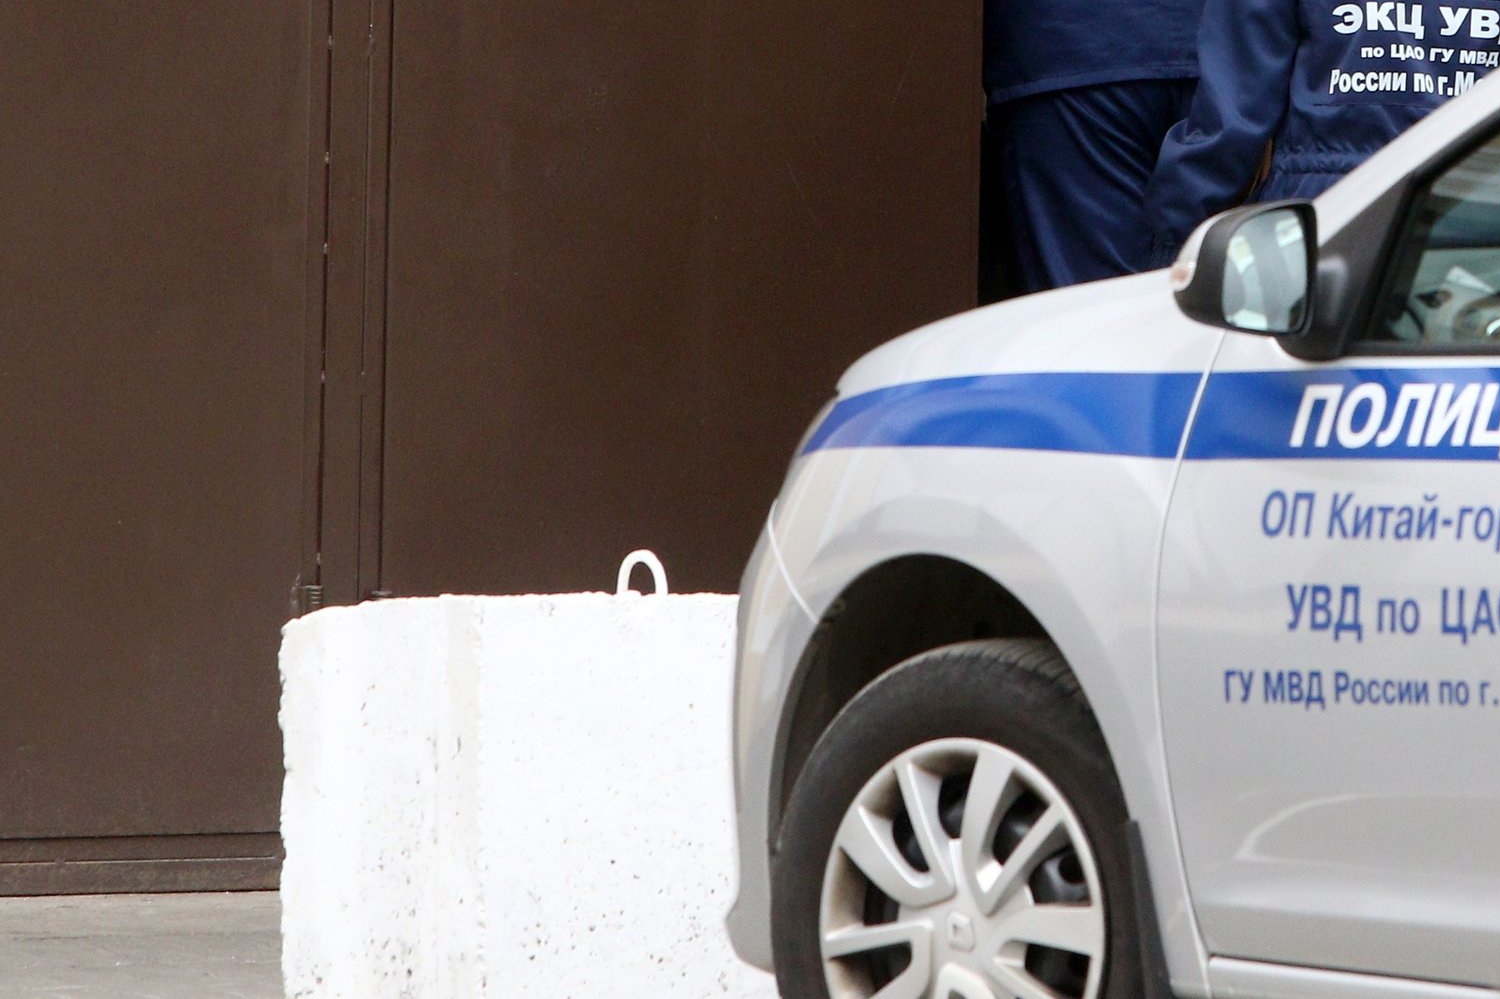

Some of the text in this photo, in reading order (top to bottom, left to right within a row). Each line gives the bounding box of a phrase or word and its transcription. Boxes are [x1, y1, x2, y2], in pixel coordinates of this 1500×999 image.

[1332, 1, 1425, 40] ЭКЦ
[1361, 43, 1500, 67] по ЦАО ГУ МВД
[1329, 68, 1407, 94] России
[1413, 73, 1434, 93] по
[1261, 490, 1315, 539] ОП
[1286, 584, 1363, 643] УВД
[1376, 598, 1421, 634] по
[1223, 671, 1254, 704] ГУ
[1263, 671, 1325, 711] МВД
[1334, 672, 1430, 706] России
[1439, 680, 1469, 707] по
[1478, 682, 1500, 707] г.
